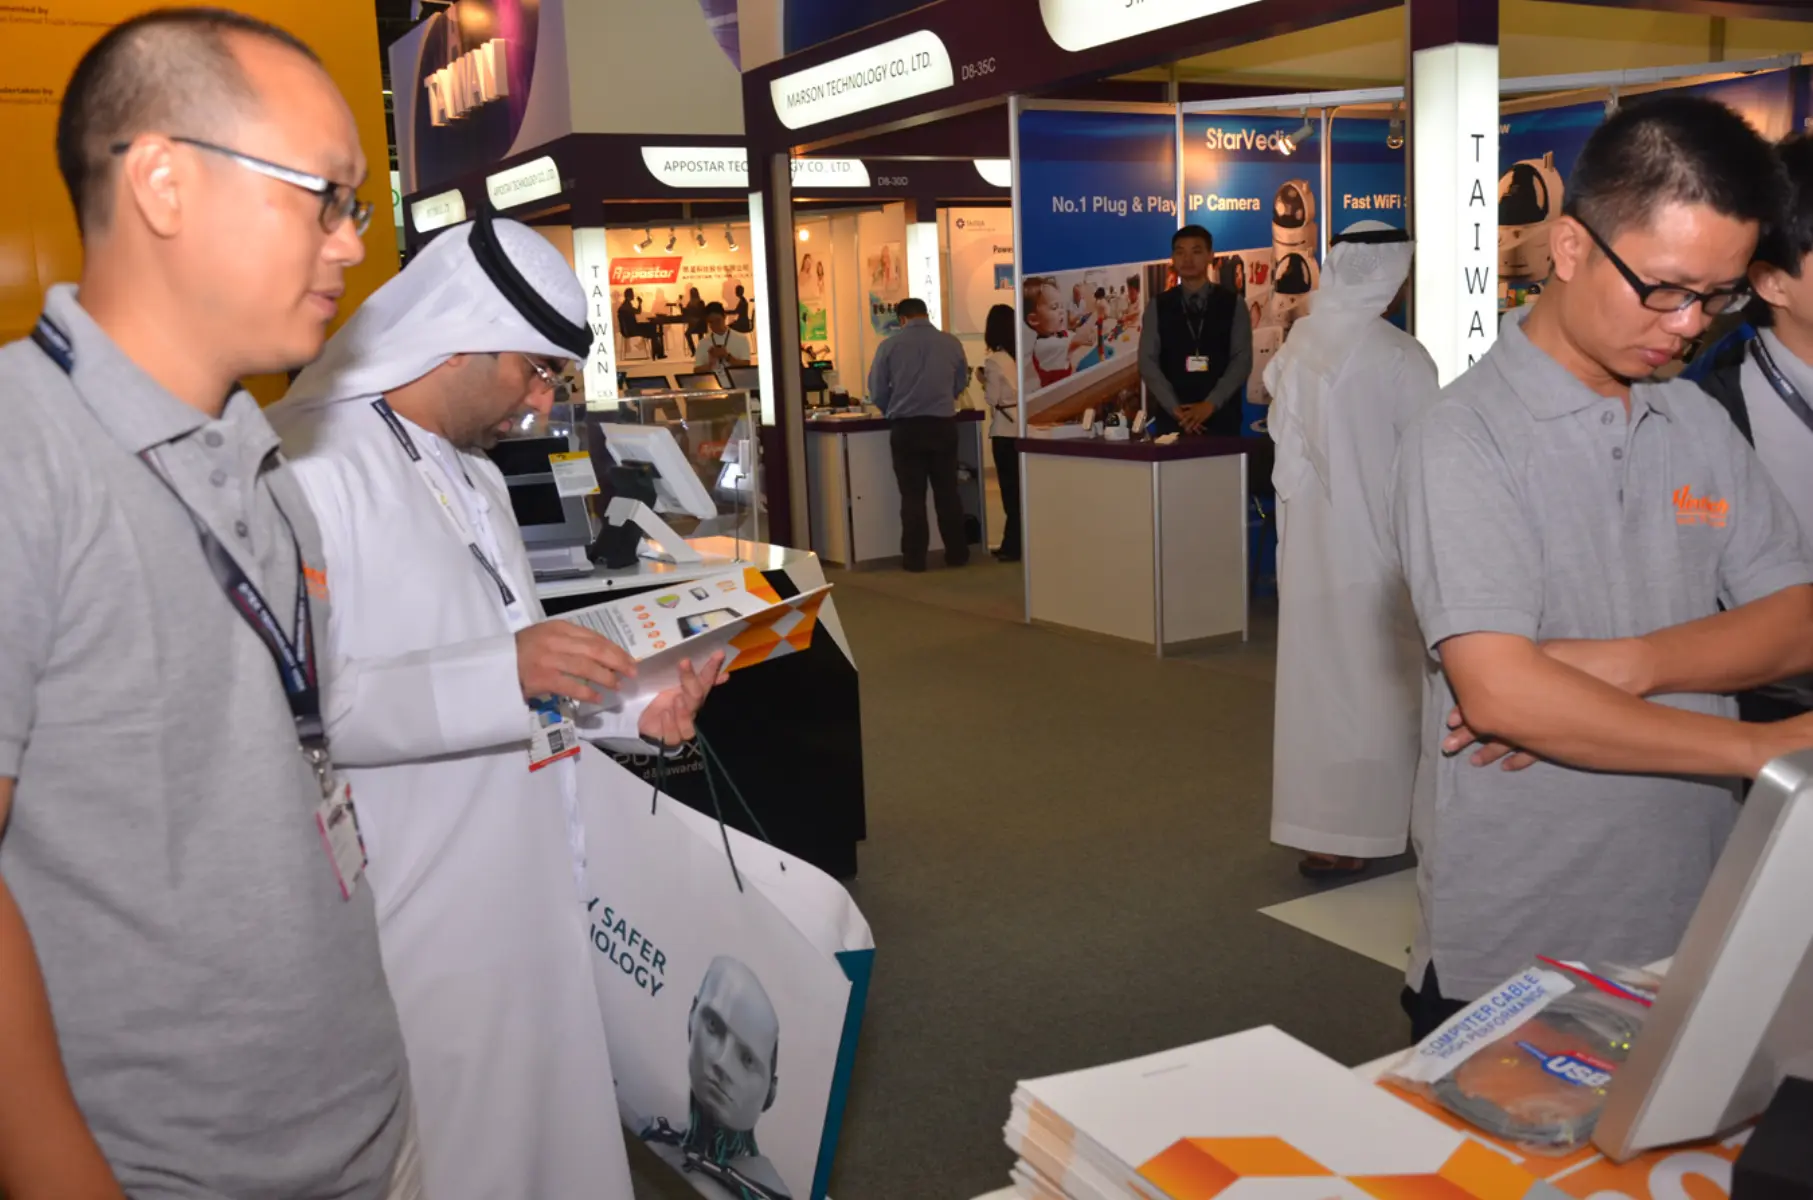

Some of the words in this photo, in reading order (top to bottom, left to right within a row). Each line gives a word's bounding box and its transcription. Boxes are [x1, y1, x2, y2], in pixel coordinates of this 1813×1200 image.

[961, 57, 996, 81] D8-35C
[786, 84, 825, 109] MARSON
[826, 65, 887, 97] TECHNOLOGY
[664, 160, 725, 173] APPOSTAR
[1052, 196, 1087, 213] No.1
[1092, 196, 1128, 216] Plug
[1132, 197, 1143, 213] &
[1147, 195, 1177, 216] Play
[1189, 194, 1203, 210] IP
[1207, 194, 1260, 211] Camera
[1343, 193, 1371, 209] Fast
[1373, 193, 1401, 209] WiFi
[612, 265, 674, 283] Appostar
[591, 265, 609, 374] TAIWAN
[601, 906, 667, 977] SAFER
[1420, 1004, 1497, 1056] COMPUTER
[1491, 973, 1540, 1008] CABLE
[1547, 1056, 1612, 1087] USB
